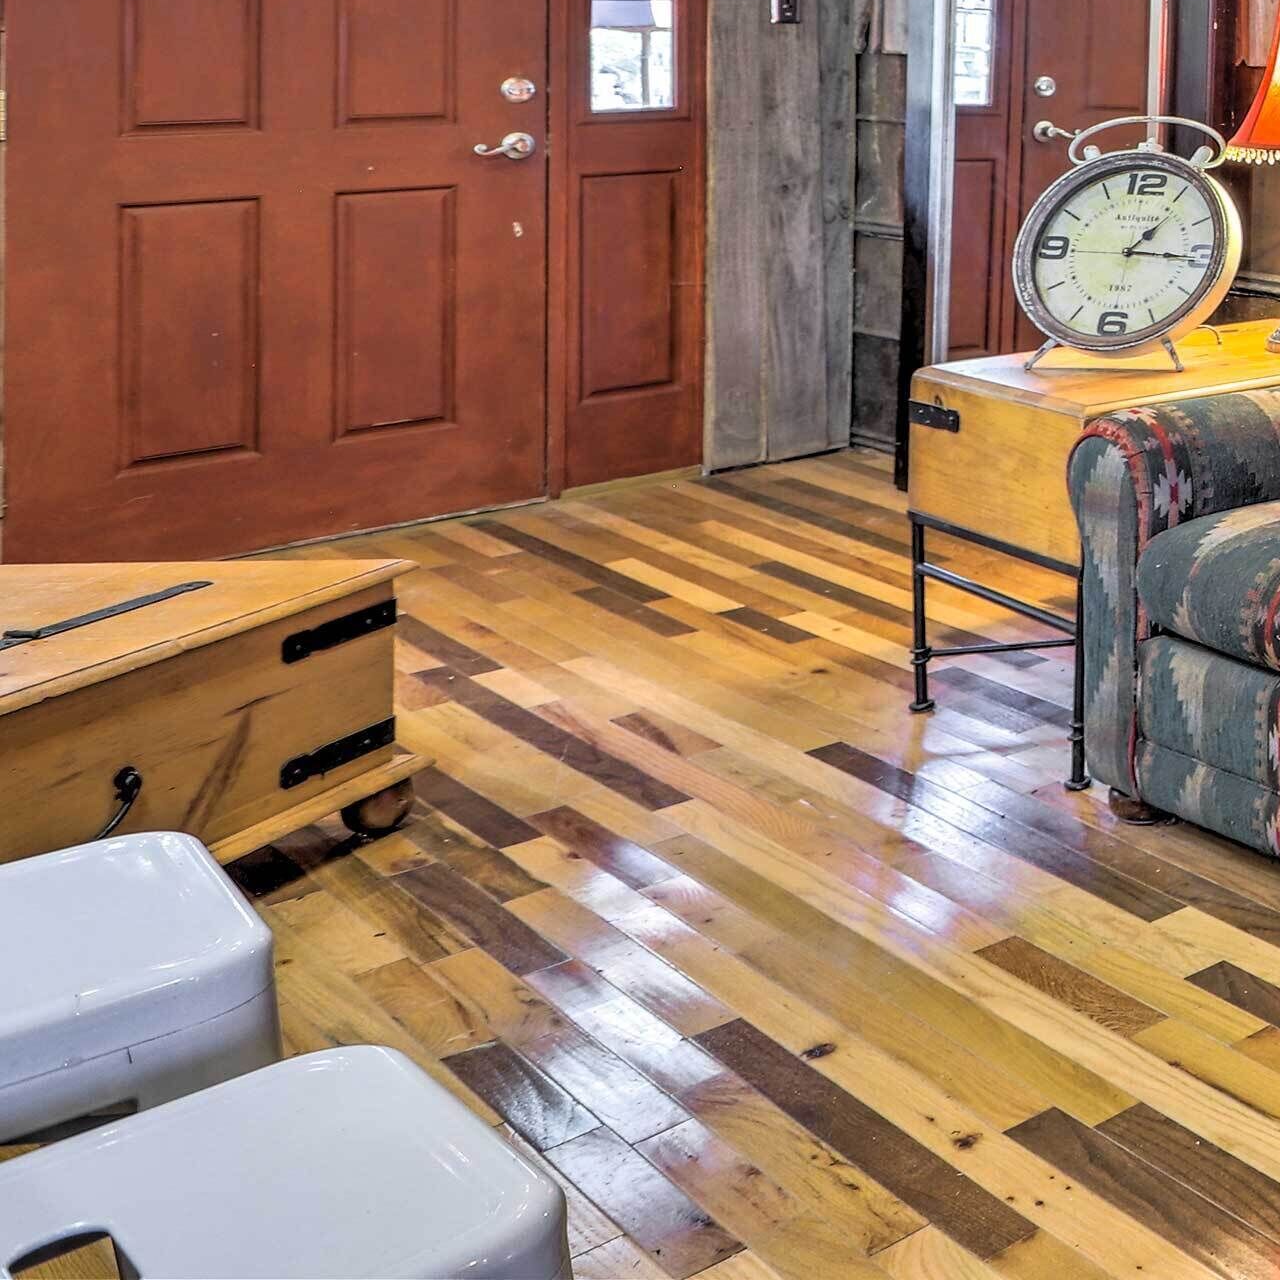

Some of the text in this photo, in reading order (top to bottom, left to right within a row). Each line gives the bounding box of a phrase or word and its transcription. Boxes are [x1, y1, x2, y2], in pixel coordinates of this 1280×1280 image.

[1127, 173, 1168, 196] 12
[1038, 235, 1070, 260] 9
[1188, 244, 1212, 269] 3
[1096, 311, 1129, 336] 6
